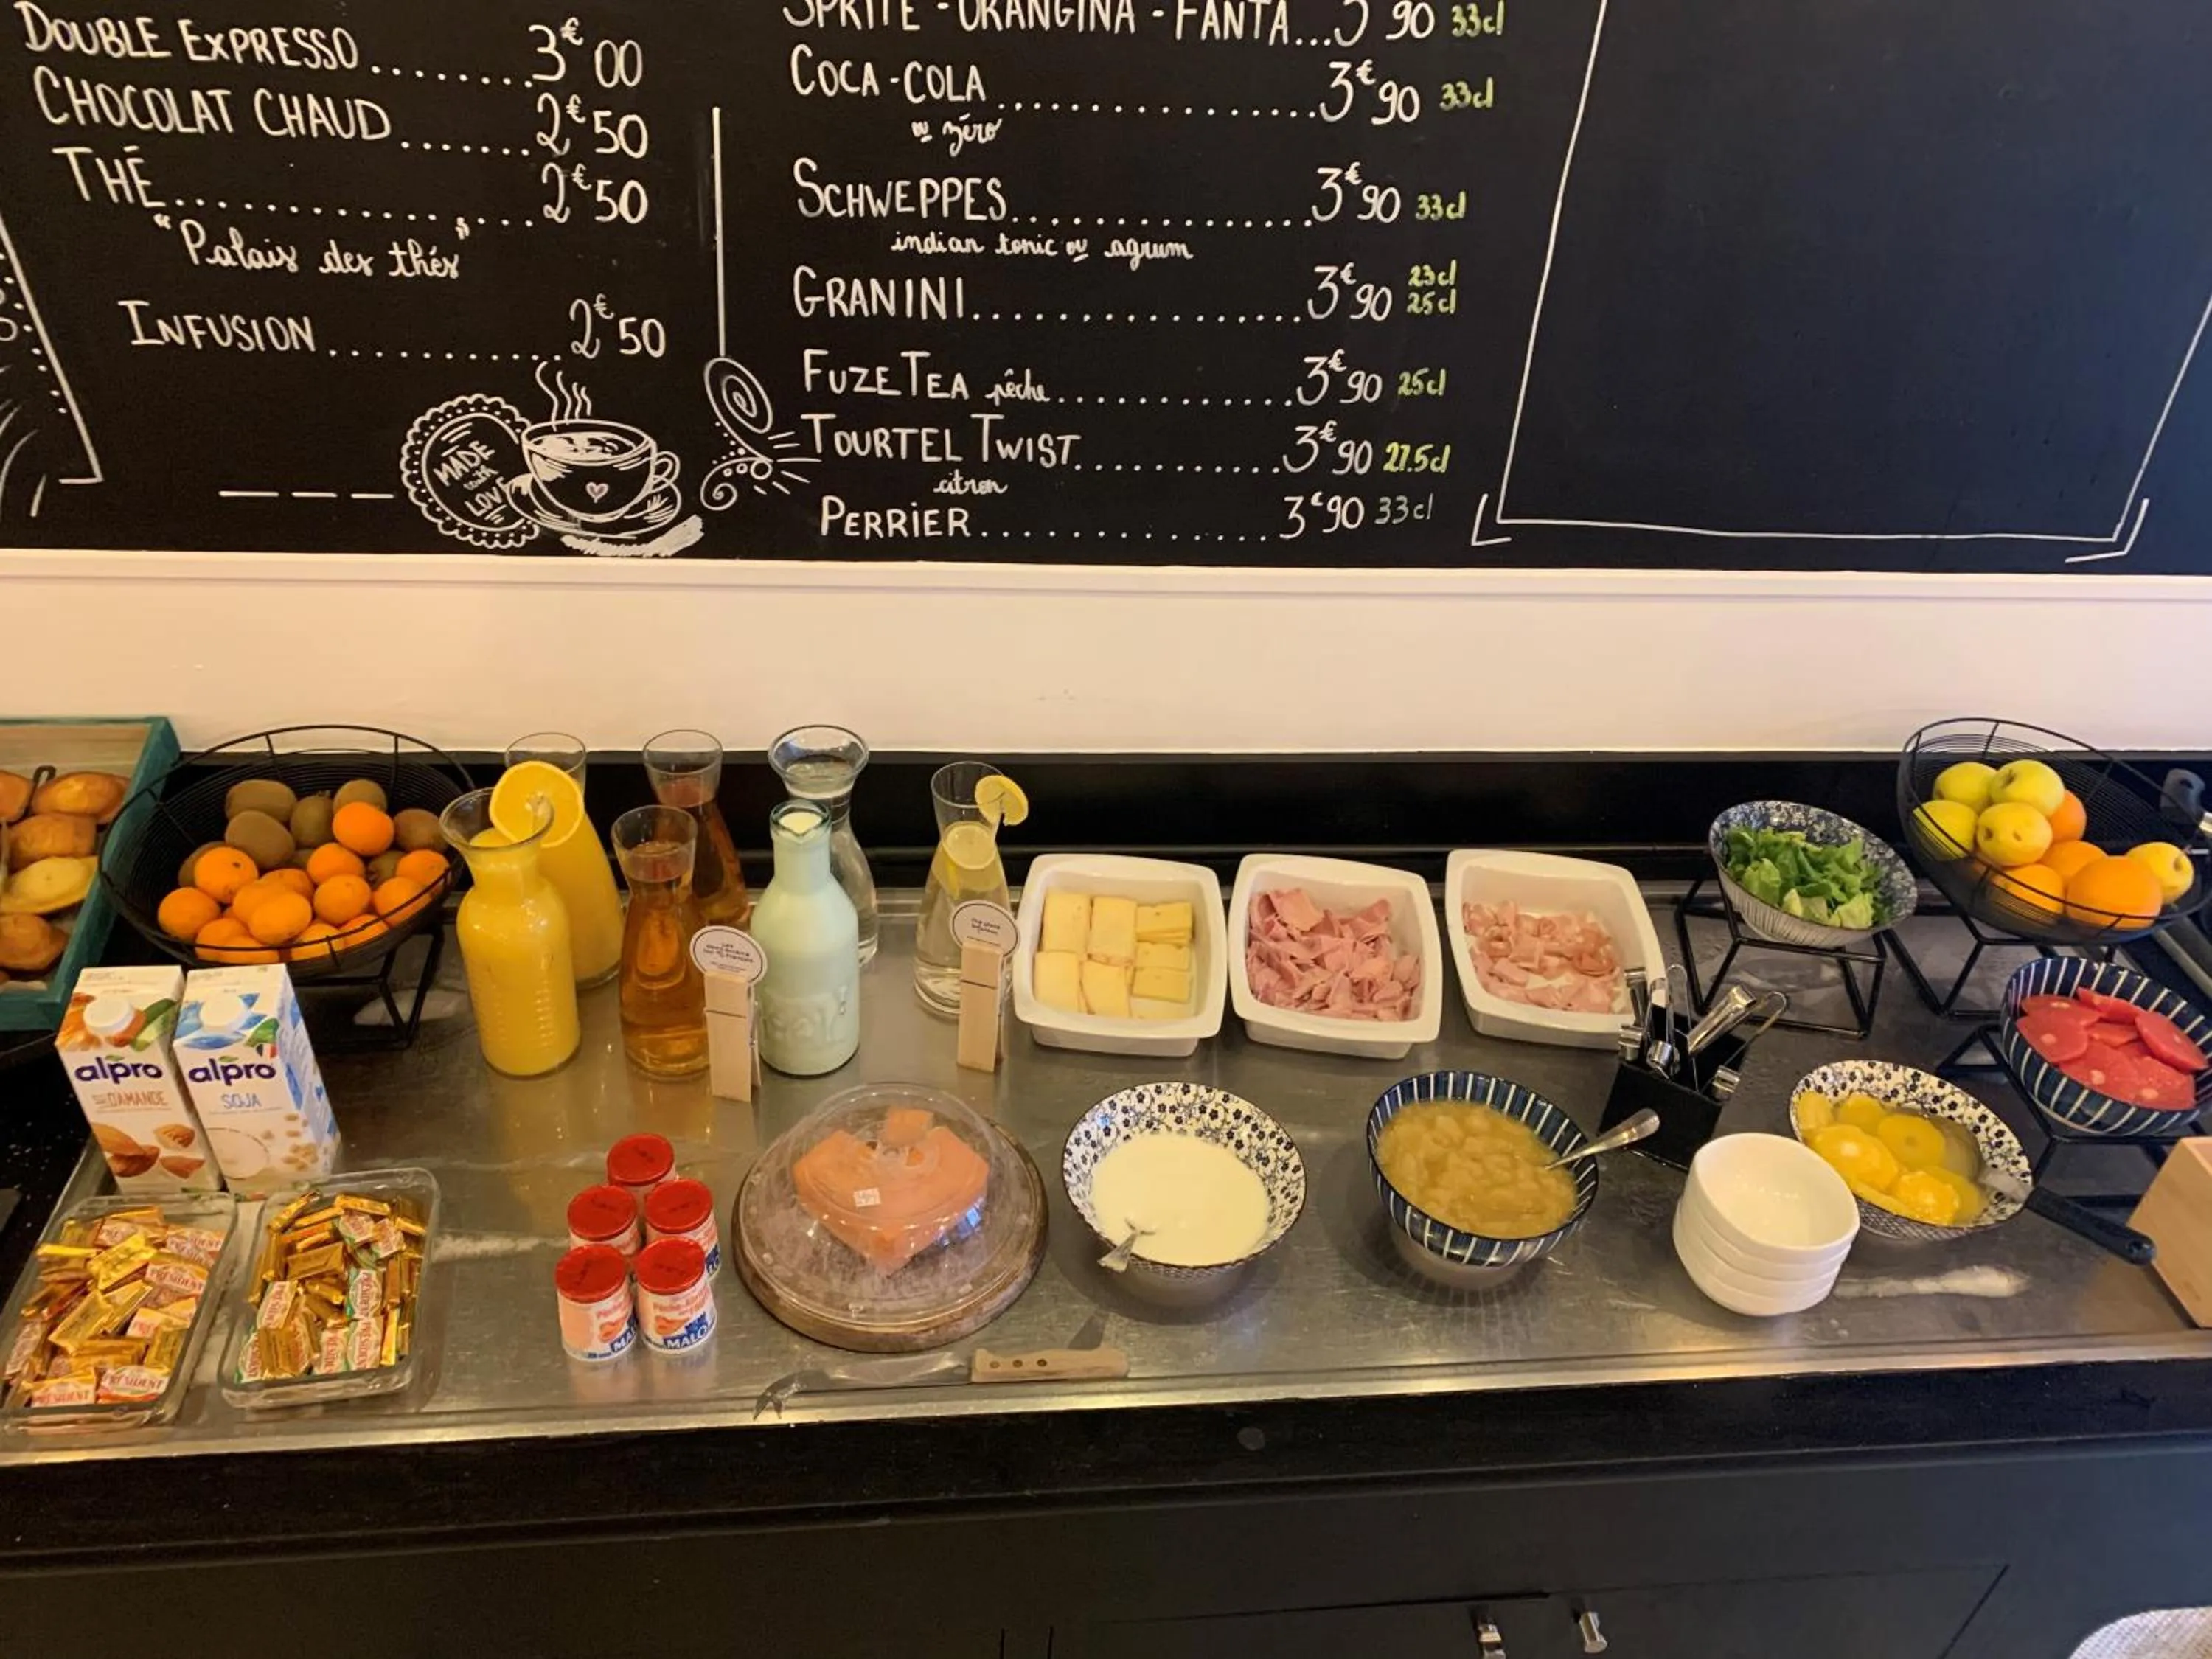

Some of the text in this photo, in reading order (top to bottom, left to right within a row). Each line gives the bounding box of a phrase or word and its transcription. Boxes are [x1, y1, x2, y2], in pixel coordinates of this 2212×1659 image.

[14, 1, 172, 58] DOUBLE
[178, 19, 359, 70] EXPRESSO
[34, 66, 234, 134] CHOCOLAT
[254, 88, 392, 141] CHAUD
[793, 156, 1007, 221] SCHWEPPES
[890, 232, 986, 254] indian
[995, 232, 1057, 256] tonic
[793, 265, 964, 321] GRANINI
[117, 299, 317, 353] INFUSION
[432, 440, 496, 487] MADE
[801, 413, 964, 462] TOURTEL
[970, 414, 1082, 469] TWIST
[74, 1056, 164, 1085] alpro
[188, 1057, 277, 1087] alpro
[220, 1093, 262, 1109] SOJA
[667, 1325, 708, 1349] MALO
